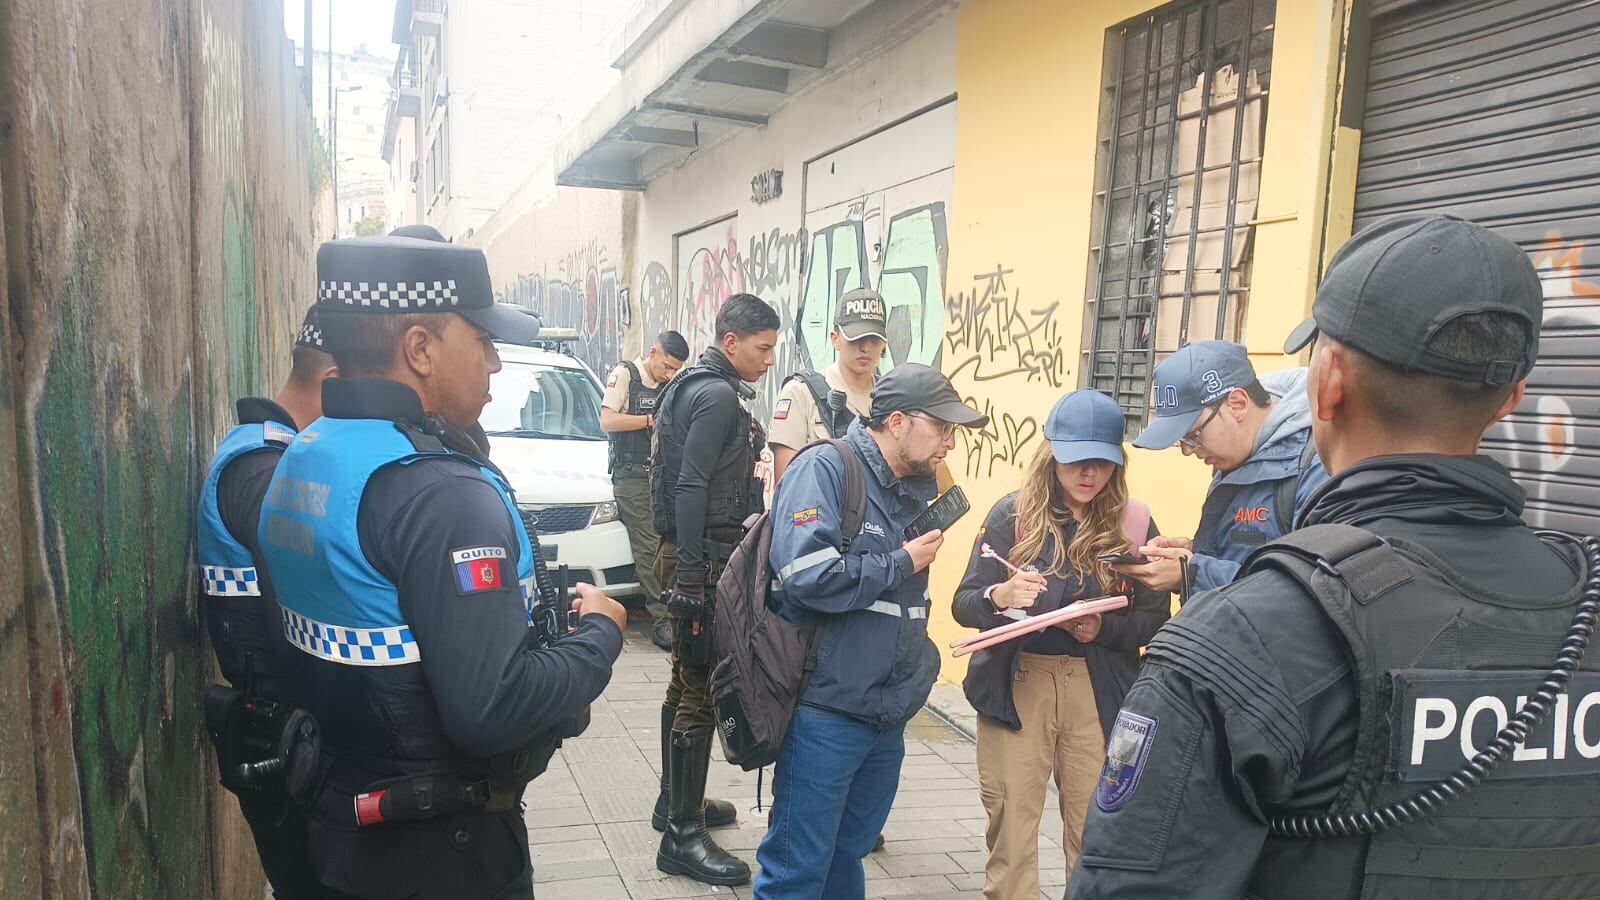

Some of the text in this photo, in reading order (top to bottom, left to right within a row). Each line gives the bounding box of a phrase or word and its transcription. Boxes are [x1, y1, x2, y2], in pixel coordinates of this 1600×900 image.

[1202, 370, 1223, 393] 3
[1235, 506, 1270, 522] AMC
[461, 548, 502, 560] QUITO
